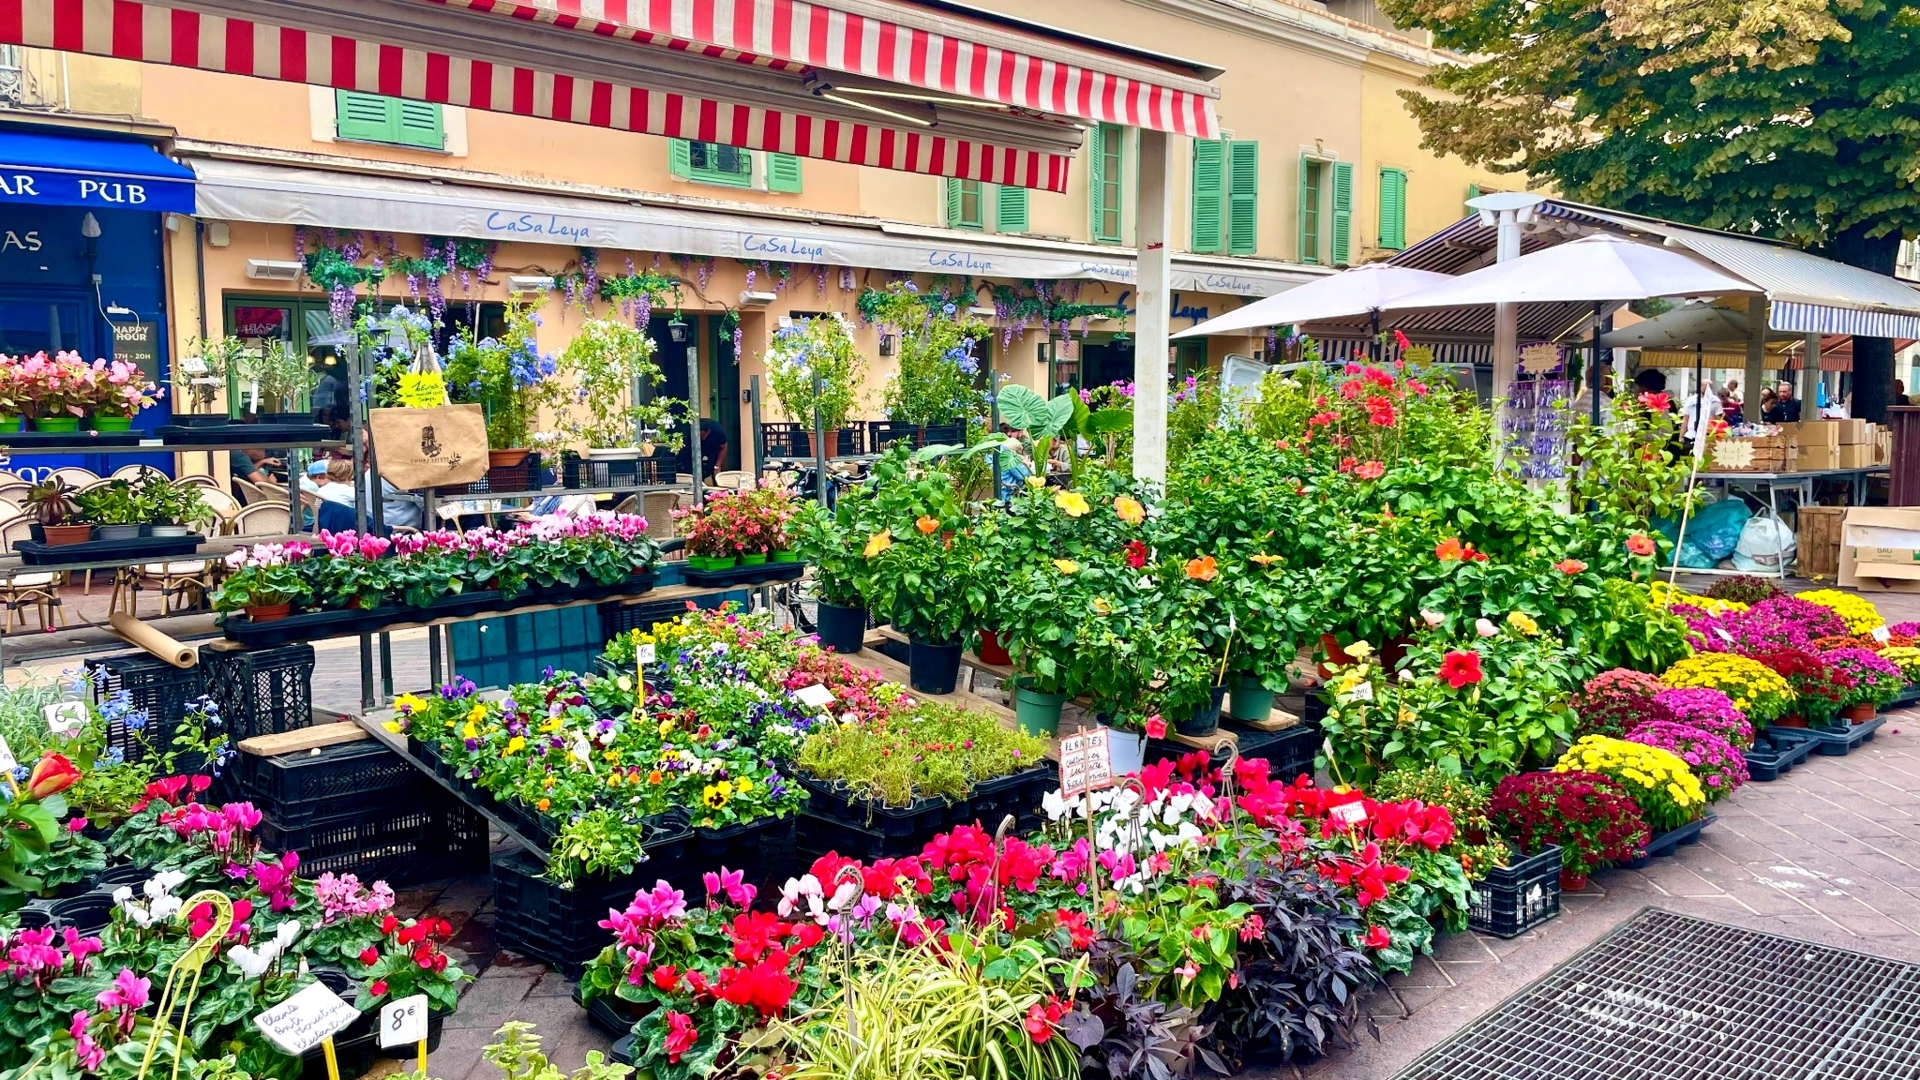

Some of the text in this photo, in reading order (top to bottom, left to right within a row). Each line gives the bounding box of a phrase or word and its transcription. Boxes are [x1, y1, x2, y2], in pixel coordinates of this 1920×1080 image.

[78, 179, 147, 204] PUB
[486, 211, 590, 243] CaSa Leya
[1, 230, 43, 252] AS
[744, 235, 823, 261] CaSa Leya
[929, 251, 992, 274] CaSa Leya
[1206, 275, 1231, 289] CaSa
[1170, 293, 1208, 326] Leya
[116, 333, 147, 341] HOUR
[392, 1006, 416, 1031] 8€
